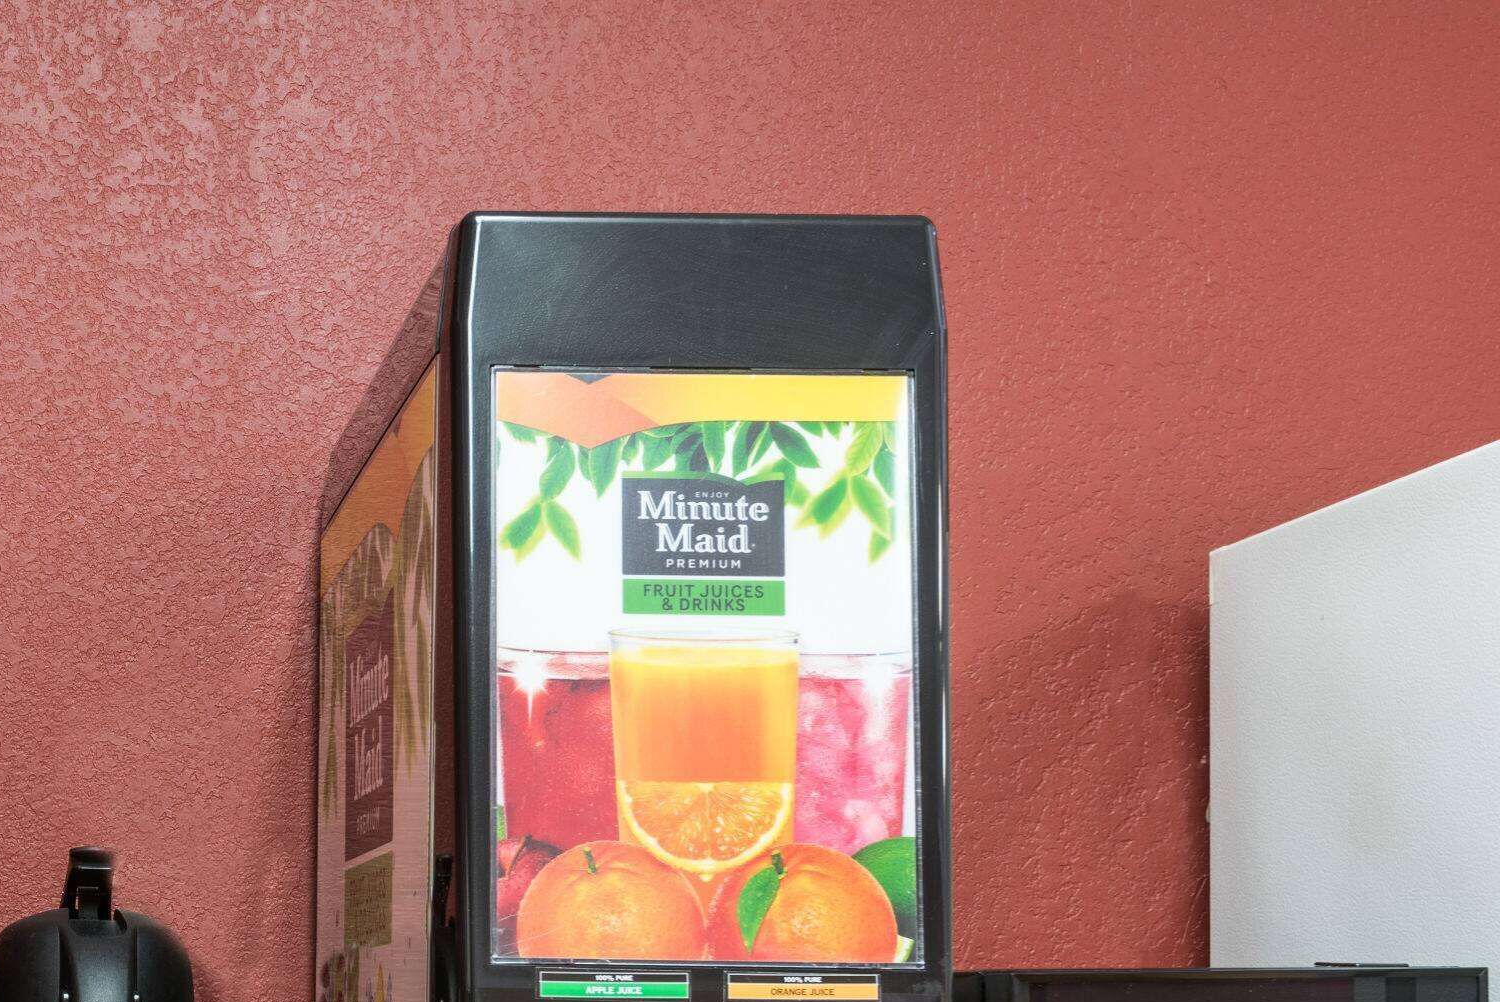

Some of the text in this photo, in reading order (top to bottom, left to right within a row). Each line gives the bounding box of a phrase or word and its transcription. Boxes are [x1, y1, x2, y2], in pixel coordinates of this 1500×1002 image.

[694, 491, 730, 499] ENJOY
[636, 490, 770, 522] Minute
[655, 522, 752, 554] Maid
[665, 558, 742, 569] PREMIUM
[643, 584, 765, 599] FRUIT JUICES
[662, 597, 746, 612] & DRINKS
[350, 642, 389, 728] Minute
[353, 715, 384, 801] Maid
[585, 986, 643, 995] APPLE JUICE
[770, 988, 835, 996] ORANGE JUICE
